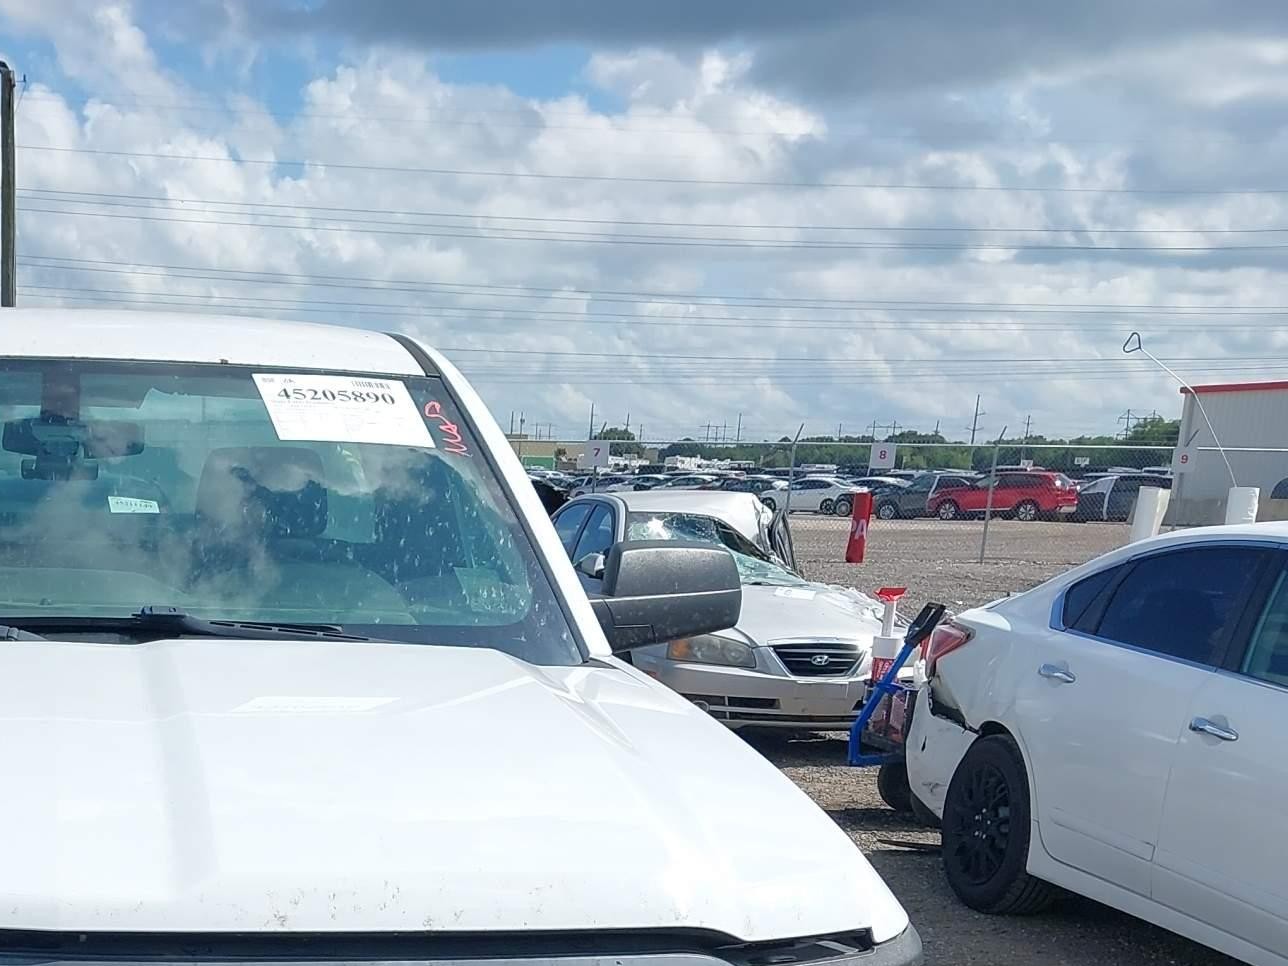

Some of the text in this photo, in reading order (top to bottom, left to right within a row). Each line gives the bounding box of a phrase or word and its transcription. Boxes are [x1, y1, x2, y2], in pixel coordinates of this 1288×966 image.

[276, 387, 396, 405] 45205890
[592, 448, 602, 457] 7
[878, 450, 888, 460] 8
[1180, 454, 1189, 464] 9
